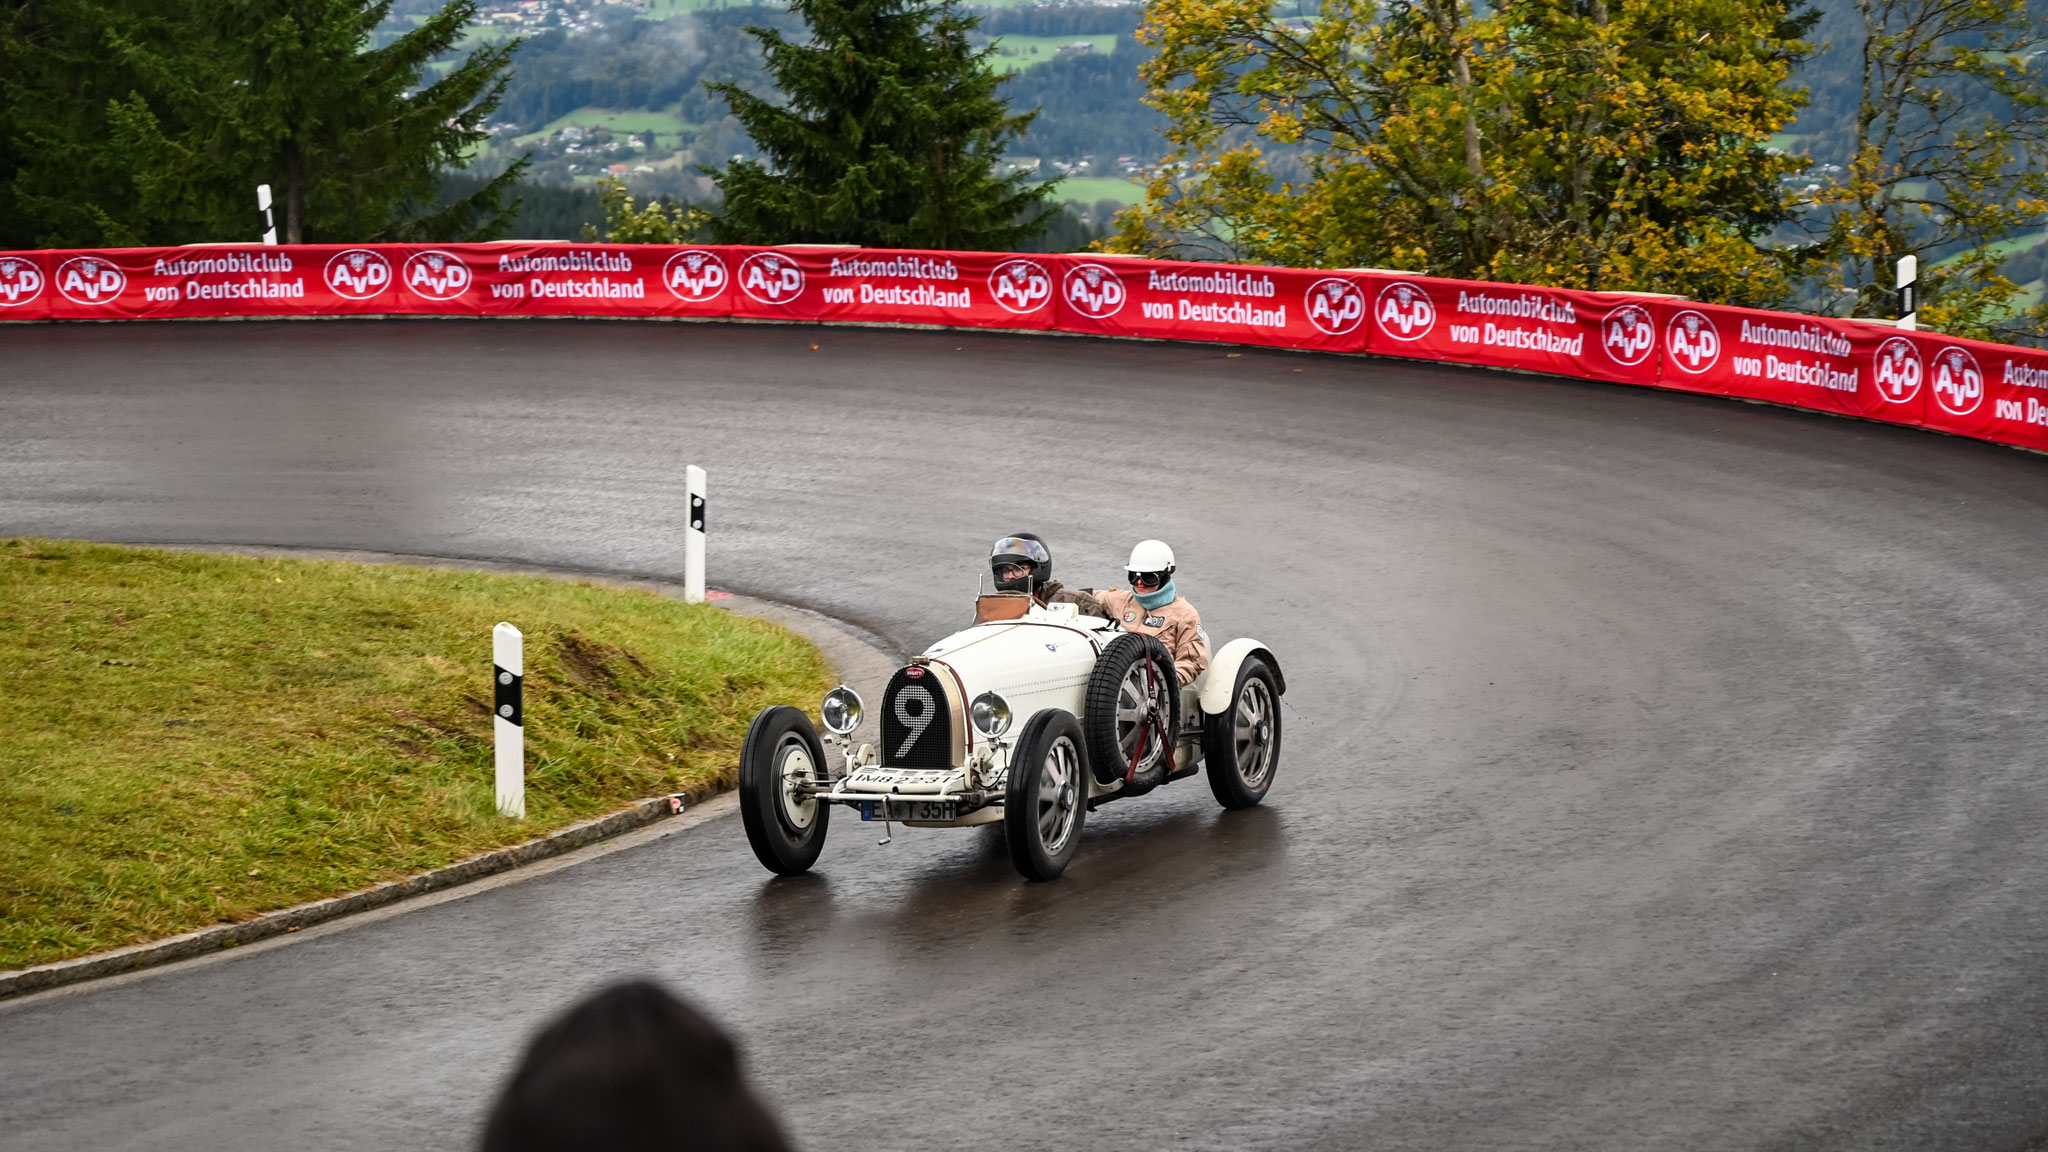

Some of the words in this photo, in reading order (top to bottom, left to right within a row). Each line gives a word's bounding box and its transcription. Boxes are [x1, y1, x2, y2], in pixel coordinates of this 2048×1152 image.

[154, 252, 293, 277] Automobilclub
[498, 251, 632, 272] Automobilclub
[830, 256, 958, 281] Automobilclub
[0, 270, 41, 300] vD
[144, 285, 179, 302] von
[187, 278, 304, 300] Deutschland
[490, 283, 524, 299] von
[531, 277, 645, 299] Deutschland
[823, 287, 854, 304] von
[860, 283, 971, 308] Deutschland
[1148, 269, 1275, 298] Automobilclub
[1142, 302, 1174, 320] von
[1179, 299, 1286, 328] Deutschland
[1458, 290, 1576, 324] Automobilclub
[1450, 324, 1479, 344] von
[1484, 323, 1584, 356] Deutschland
[1740, 319, 1852, 358] Automobilclub
[1733, 356, 1762, 377] von
[1766, 354, 1859, 393] Deutschland
[1996, 398, 2023, 421] von
[2027, 397, 2048, 427] De
[894, 684, 936, 759] 9
[920, 801, 955, 819] 35H
